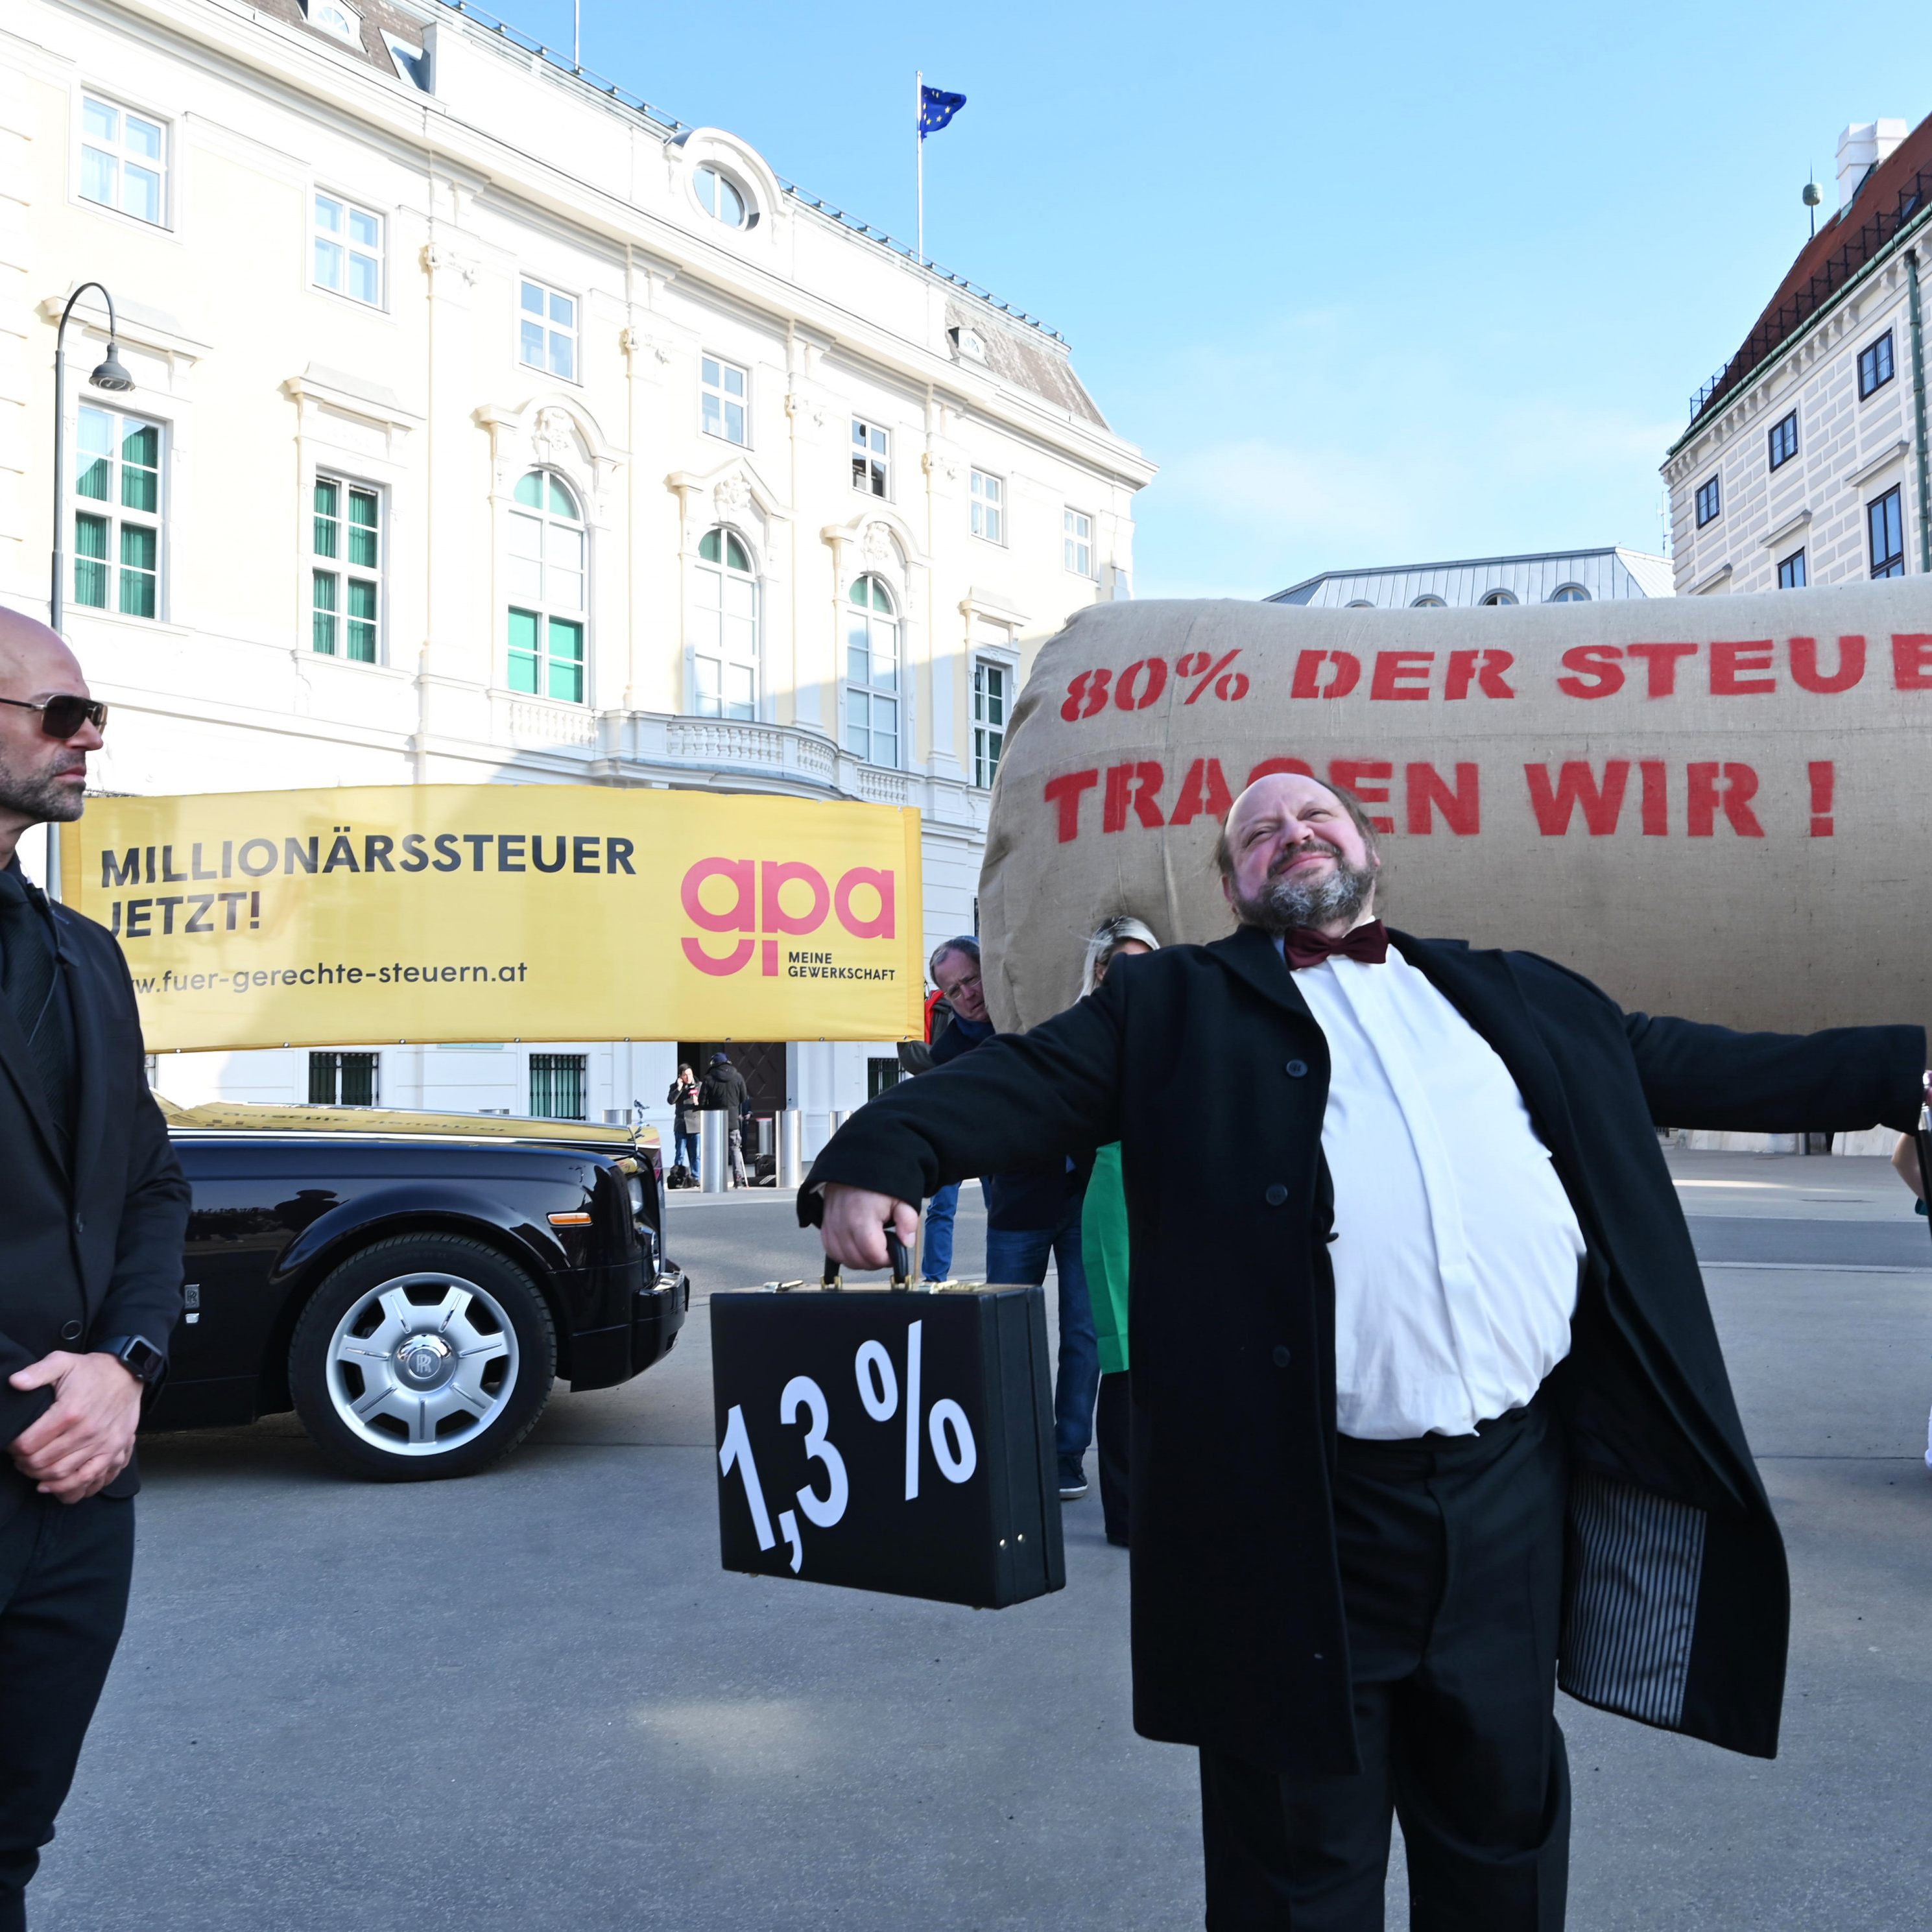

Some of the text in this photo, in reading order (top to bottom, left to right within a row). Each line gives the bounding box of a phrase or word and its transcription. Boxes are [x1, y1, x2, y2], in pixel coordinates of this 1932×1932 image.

[1061, 649, 1250, 722] 80%
[1291, 649, 1514, 700] DER
[1045, 758, 1480, 843] TRAEN
[1524, 760, 1765, 837] WIR
[101, 826, 636, 888] MILLIONÄRSSTEUER
[111, 891, 260, 938] JETZT!
[681, 857, 896, 977] gpa
[132, 962, 529, 994] w.fuer-gerechte-steuern.at
[788, 951, 833, 964] MEINE
[788, 966, 896, 981] GEWERKSCHAFT
